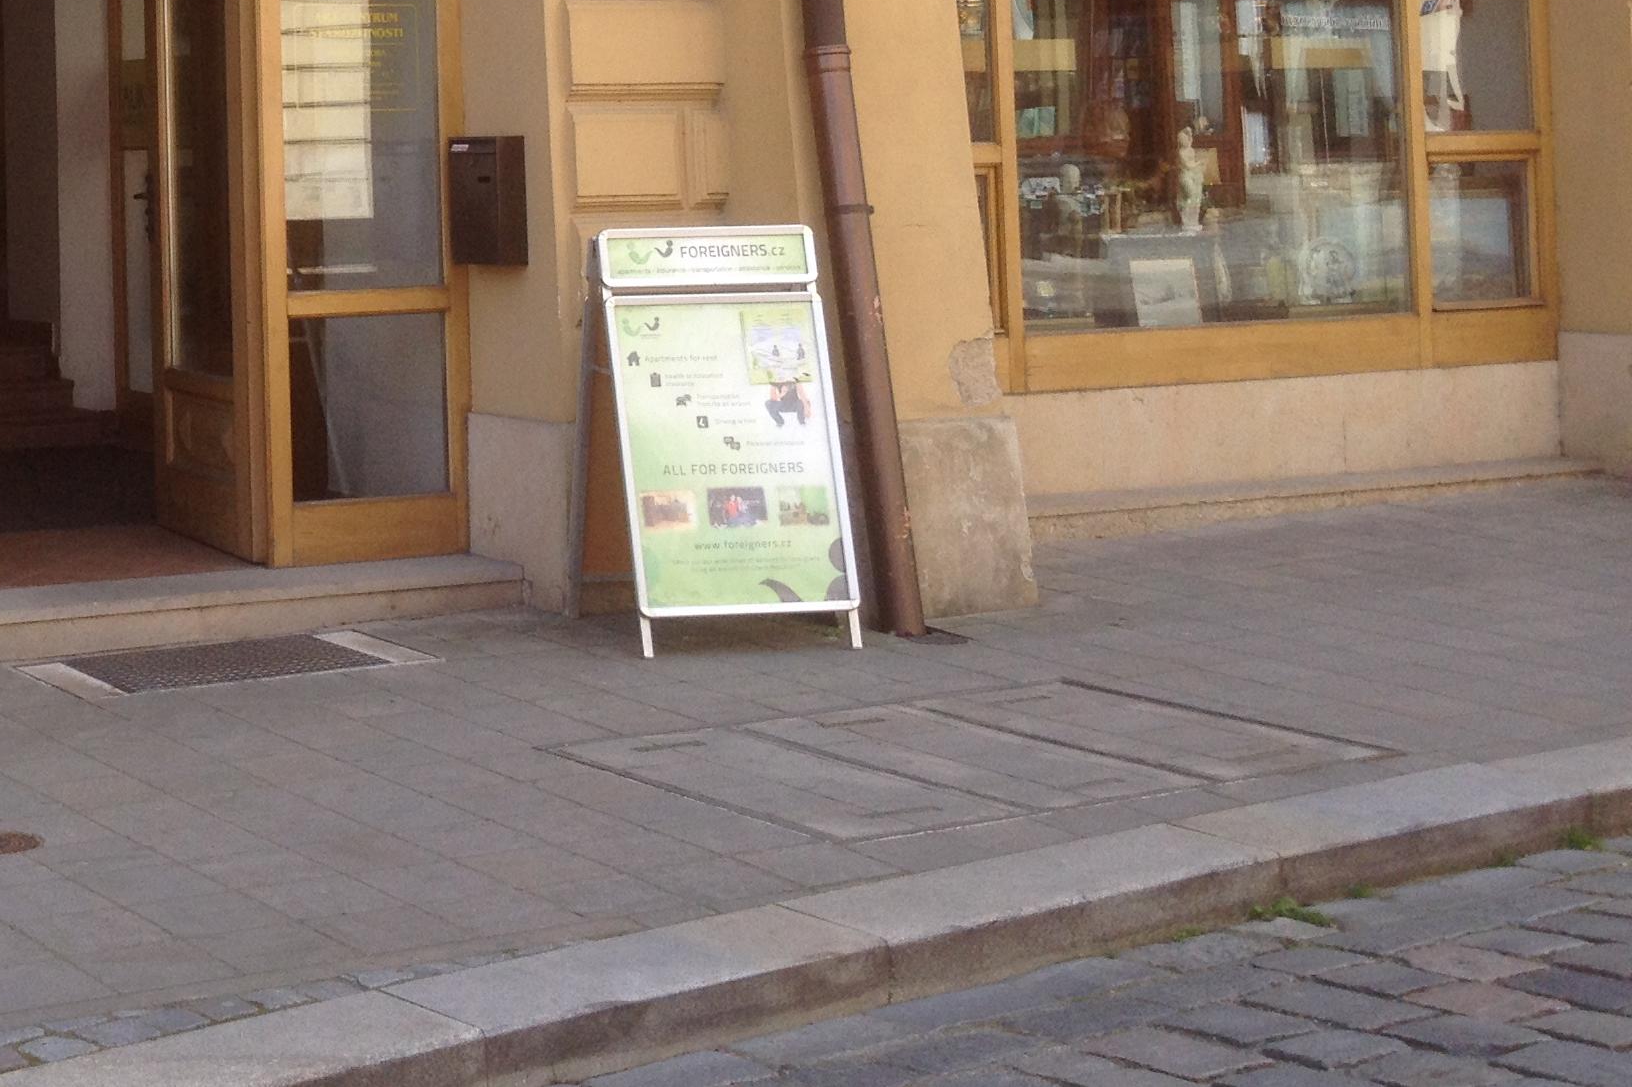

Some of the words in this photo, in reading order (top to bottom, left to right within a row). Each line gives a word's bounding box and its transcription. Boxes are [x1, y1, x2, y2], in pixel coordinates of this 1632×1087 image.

[680, 244, 785, 258] FOREIGNERS.cz
[663, 464, 686, 476] ALL
[692, 463, 718, 475] FOR
[722, 461, 805, 475] FOREIGNERS
